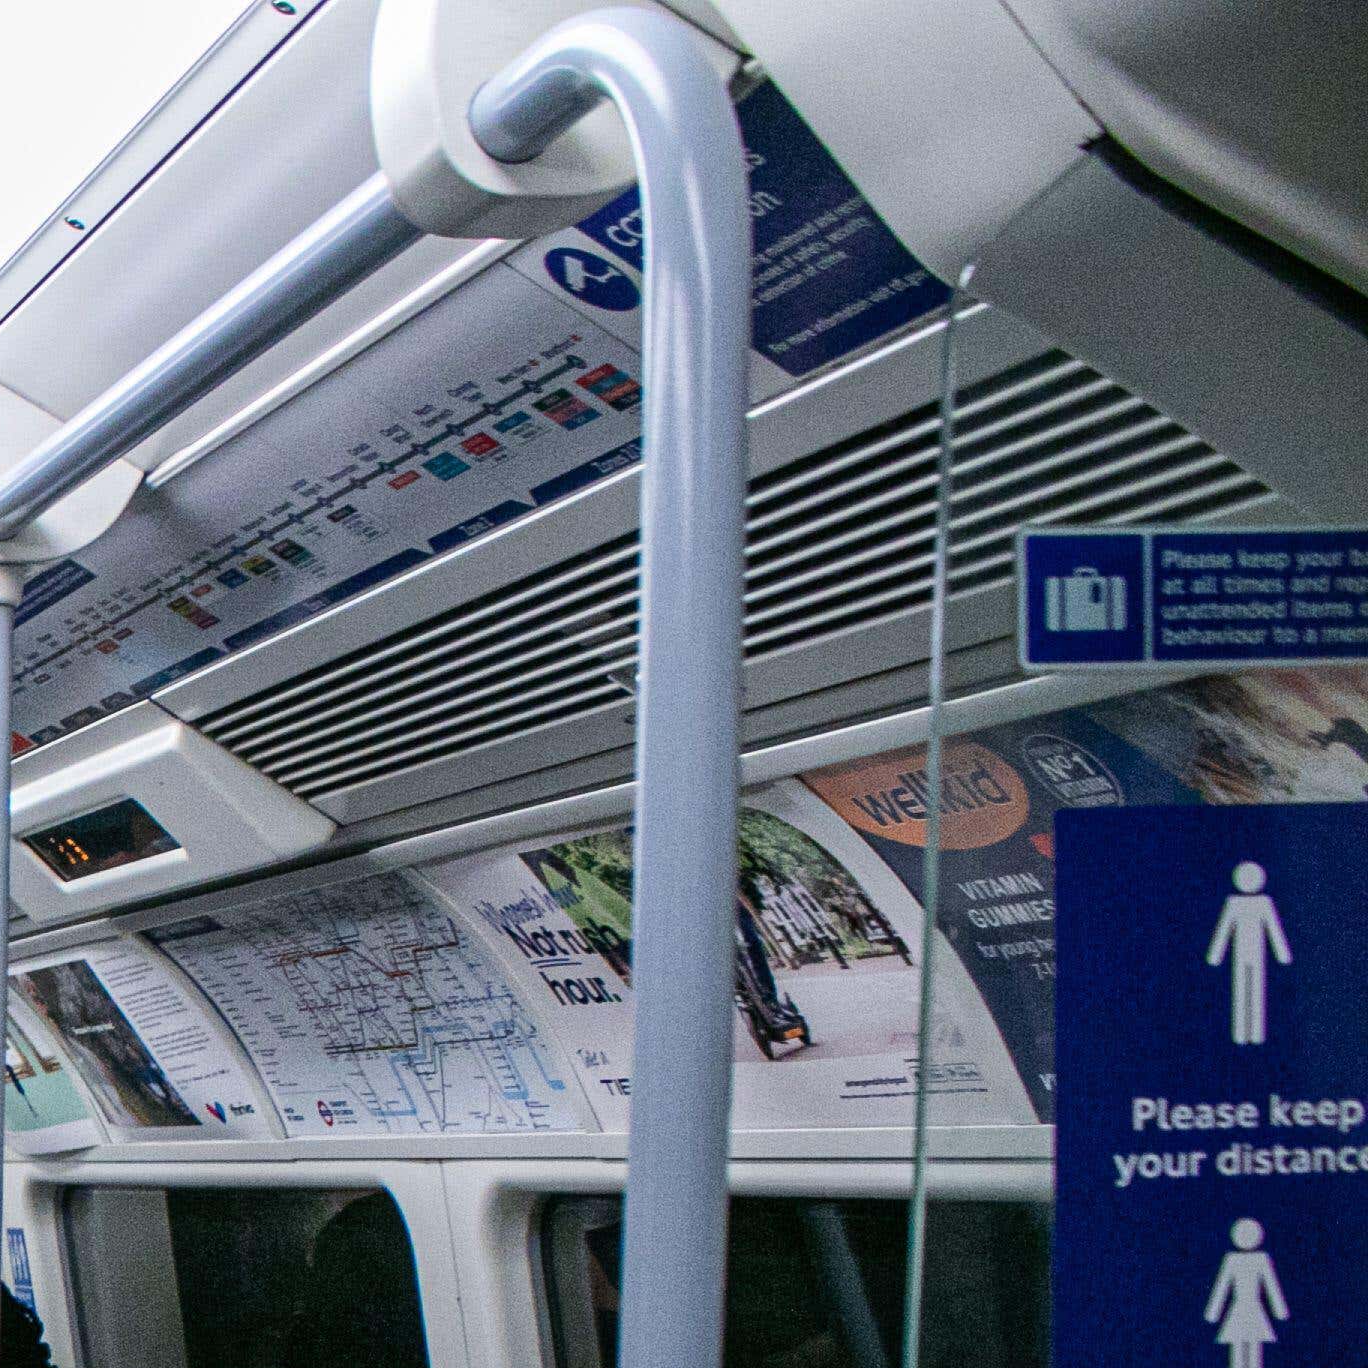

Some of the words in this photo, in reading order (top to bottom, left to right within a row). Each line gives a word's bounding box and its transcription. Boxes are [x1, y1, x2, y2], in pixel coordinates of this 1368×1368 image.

[957, 872, 1044, 900] VITAMIN
[501, 923, 570, 959] Not
[558, 917, 622, 955] rush
[539, 971, 622, 1006] hour.
[1131, 1097, 1259, 1131] Please
[1269, 1094, 1365, 1132] keep
[1113, 1152, 1208, 1188] your
